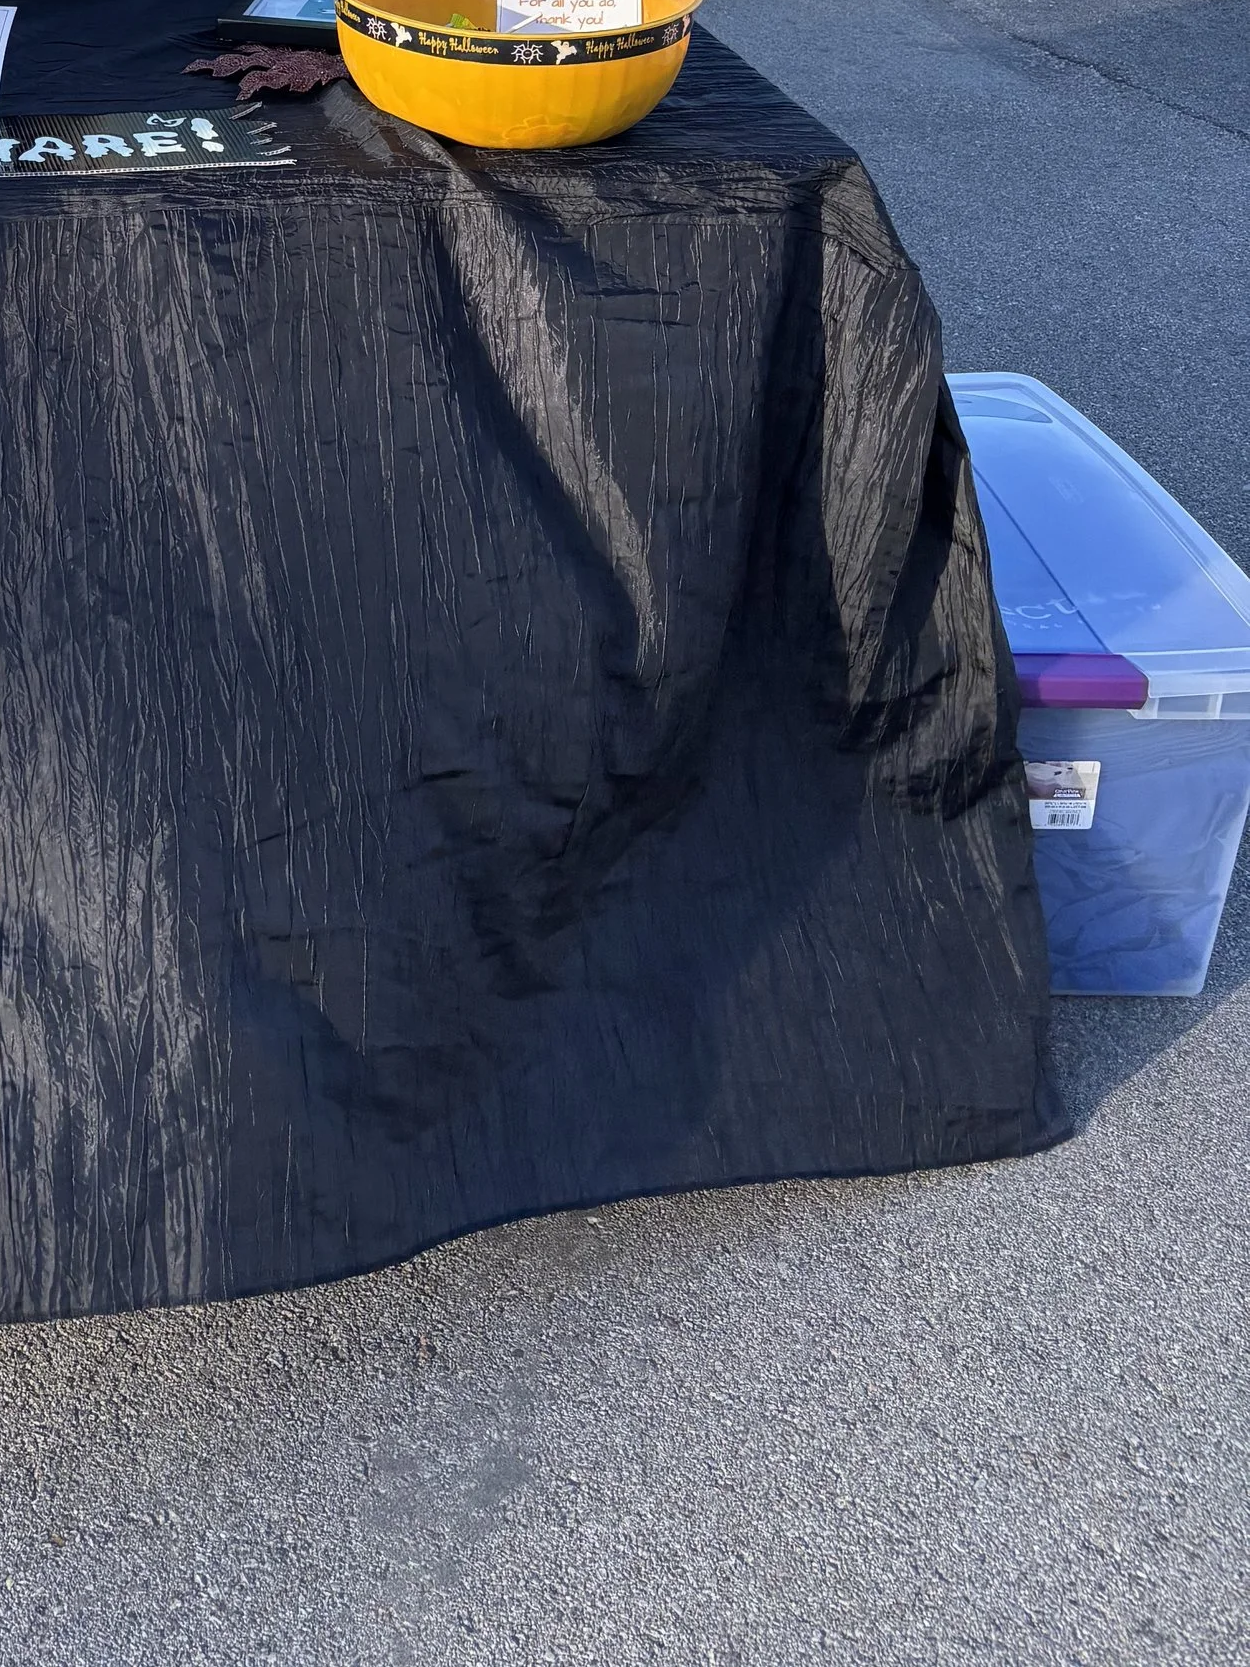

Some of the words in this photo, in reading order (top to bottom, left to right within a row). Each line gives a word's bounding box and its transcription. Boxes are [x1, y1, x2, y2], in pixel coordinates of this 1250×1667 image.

[570, 0, 594, 13] you
[577, 10, 604, 30] you!
[418, 31, 448, 56] Happy
[448, 36, 500, 55] Halloween
[585, 38, 615, 59] Happy
[616, 33, 655, 51] Halloween
